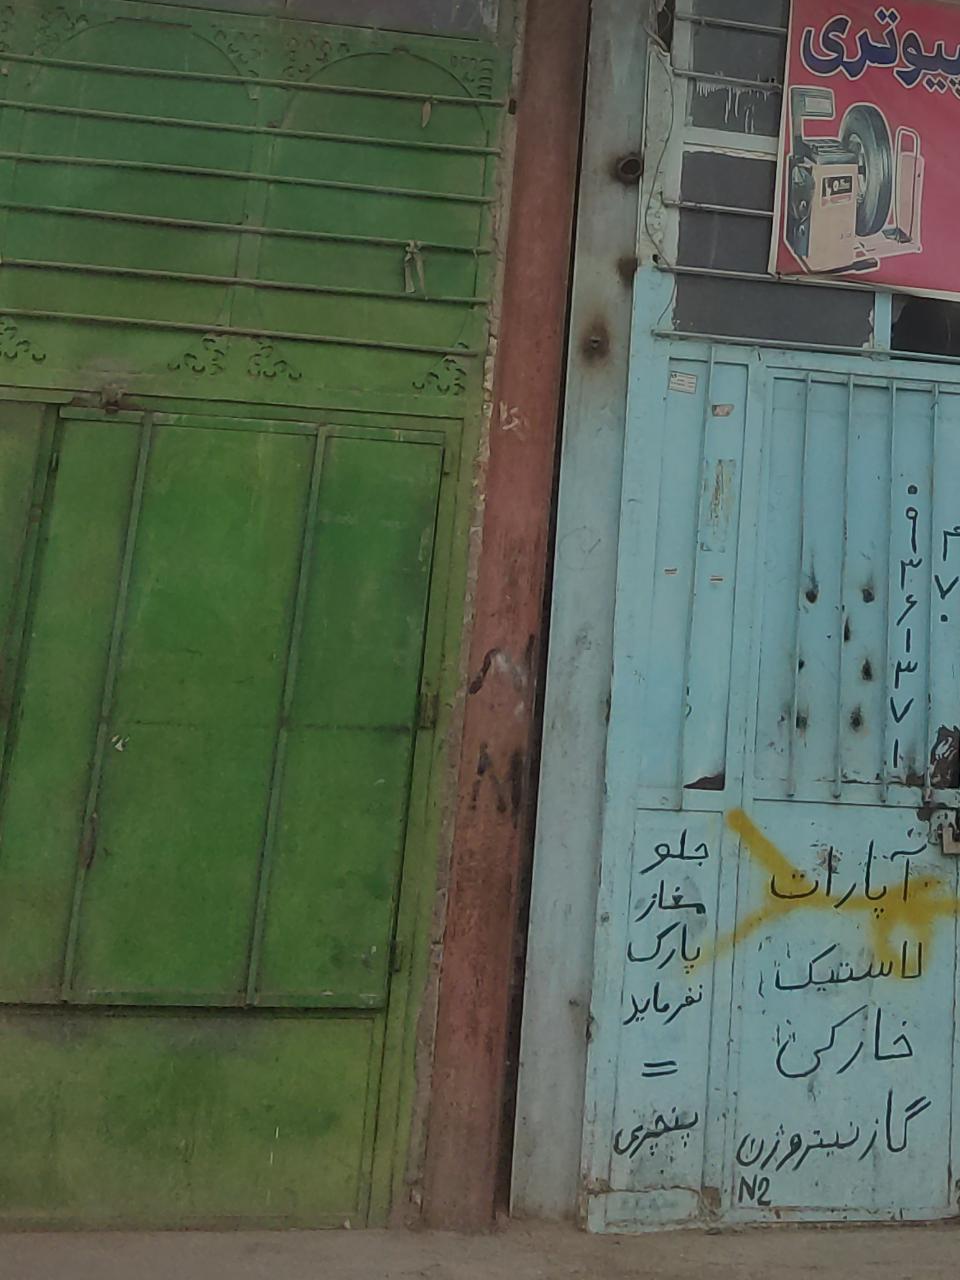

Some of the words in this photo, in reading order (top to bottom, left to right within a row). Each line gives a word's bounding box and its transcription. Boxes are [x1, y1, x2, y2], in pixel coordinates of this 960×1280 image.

[639, 828, 709, 874] جلو
[770, 839, 927, 919] آپارات
[627, 922, 701, 974] پارک
[775, 940, 922, 992] لاستیک
[736, 1121, 860, 1171] نیتروژن
[857, 1088, 932, 1161] گاز
[738, 1174, 772, 1206] N2
